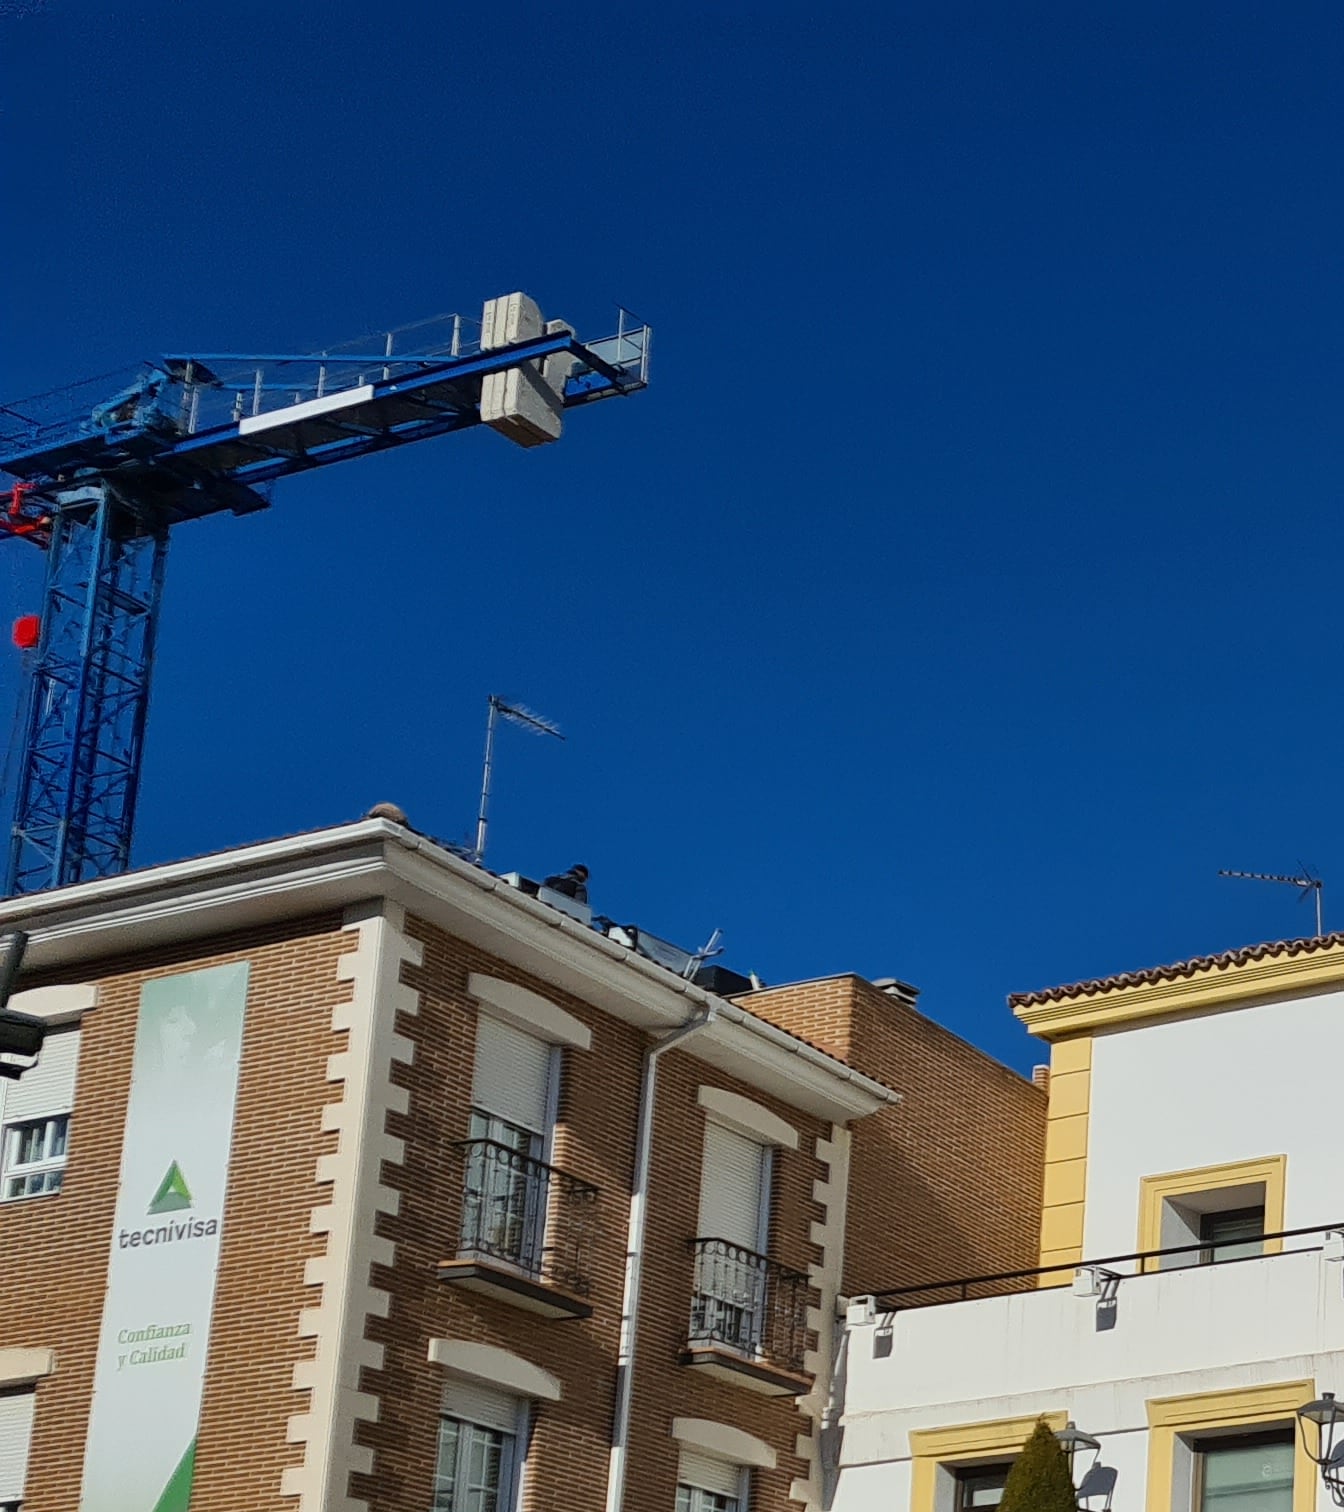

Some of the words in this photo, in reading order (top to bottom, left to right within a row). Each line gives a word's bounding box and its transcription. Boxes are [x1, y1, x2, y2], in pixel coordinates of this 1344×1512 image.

[118, 1216, 218, 1249] tecnivisa
[117, 1323, 191, 1344] Confianza
[117, 1354, 127, 1371] y
[129, 1343, 186, 1365] Calidad
